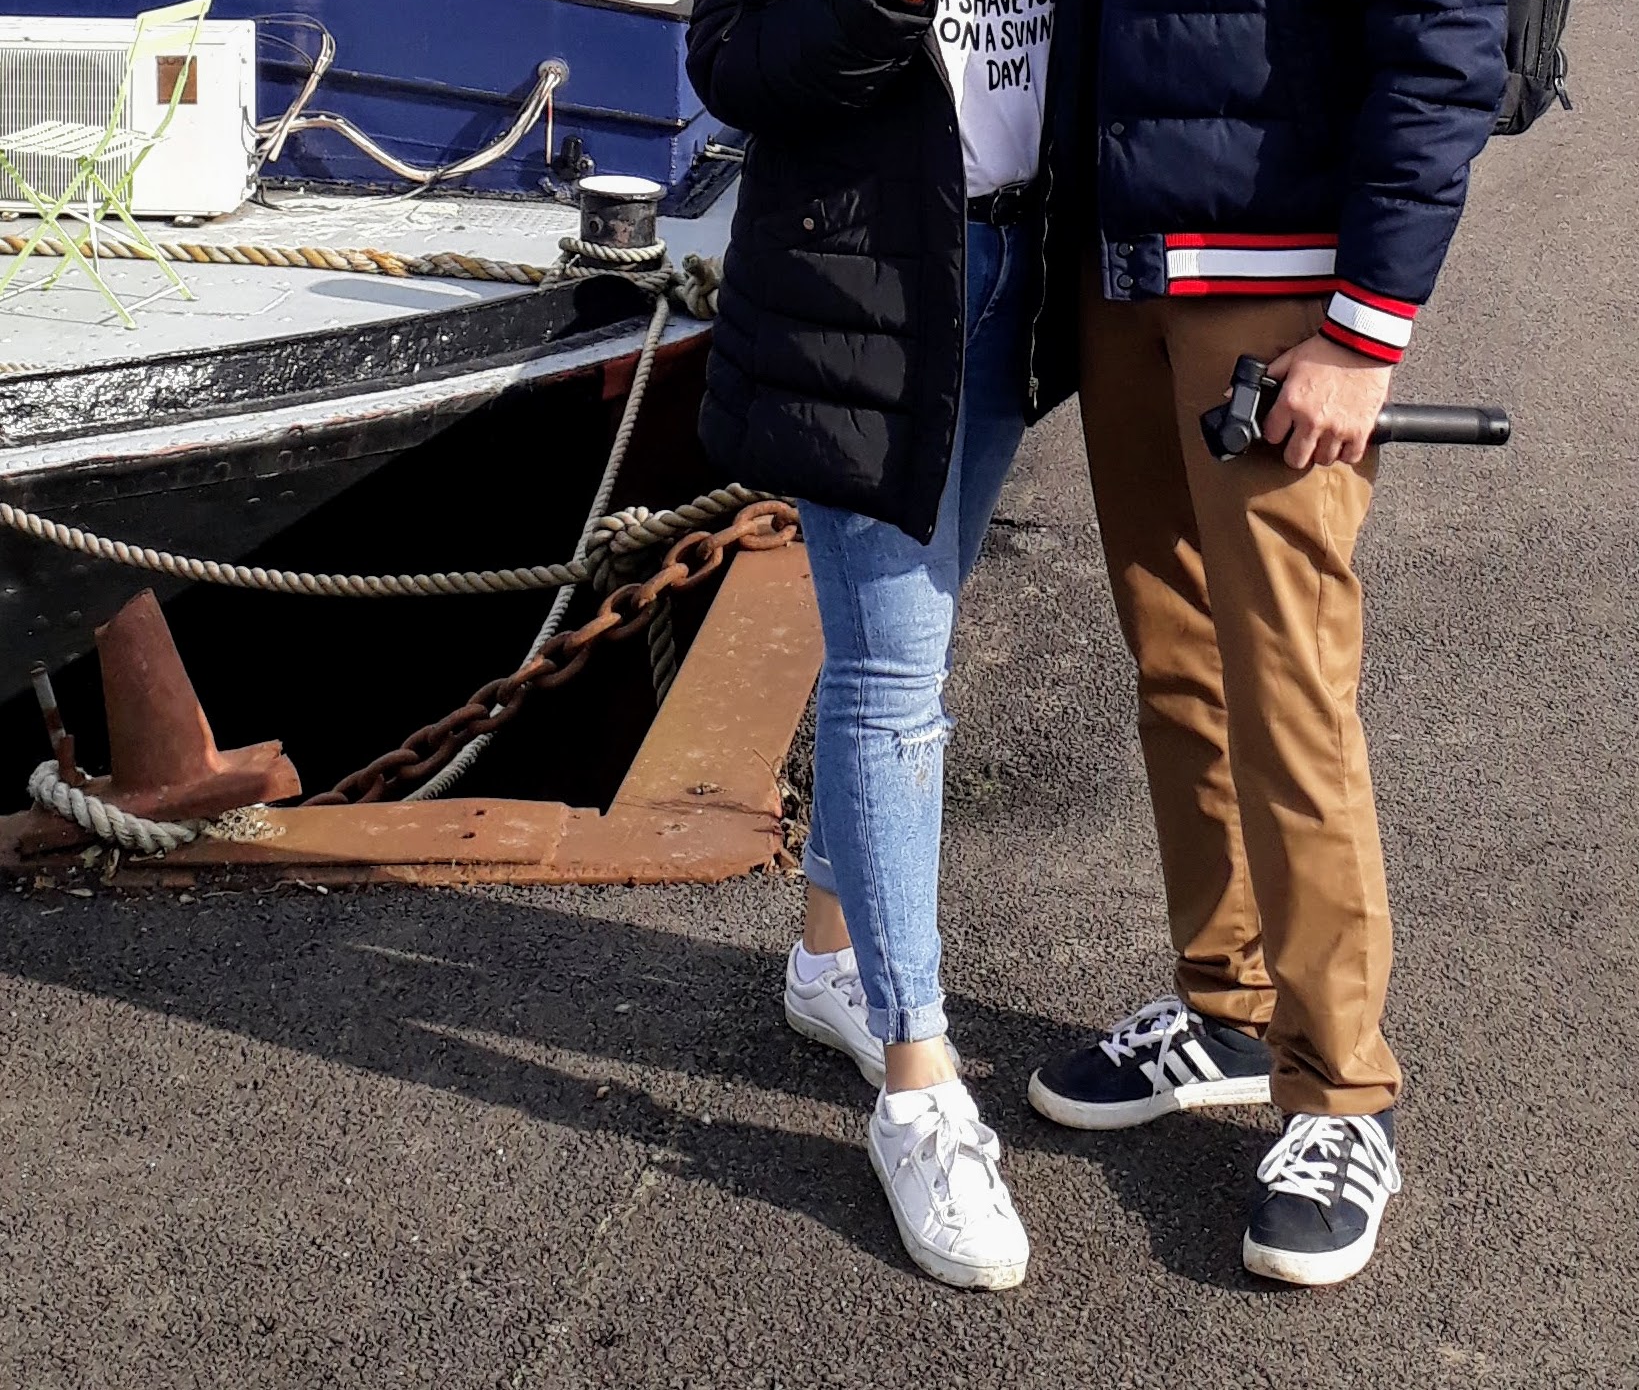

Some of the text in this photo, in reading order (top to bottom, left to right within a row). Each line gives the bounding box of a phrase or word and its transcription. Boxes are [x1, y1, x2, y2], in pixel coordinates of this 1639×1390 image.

[940, 17, 980, 51] ON
[985, 23, 997, 53] A
[986, 51, 1031, 91] DAY!
